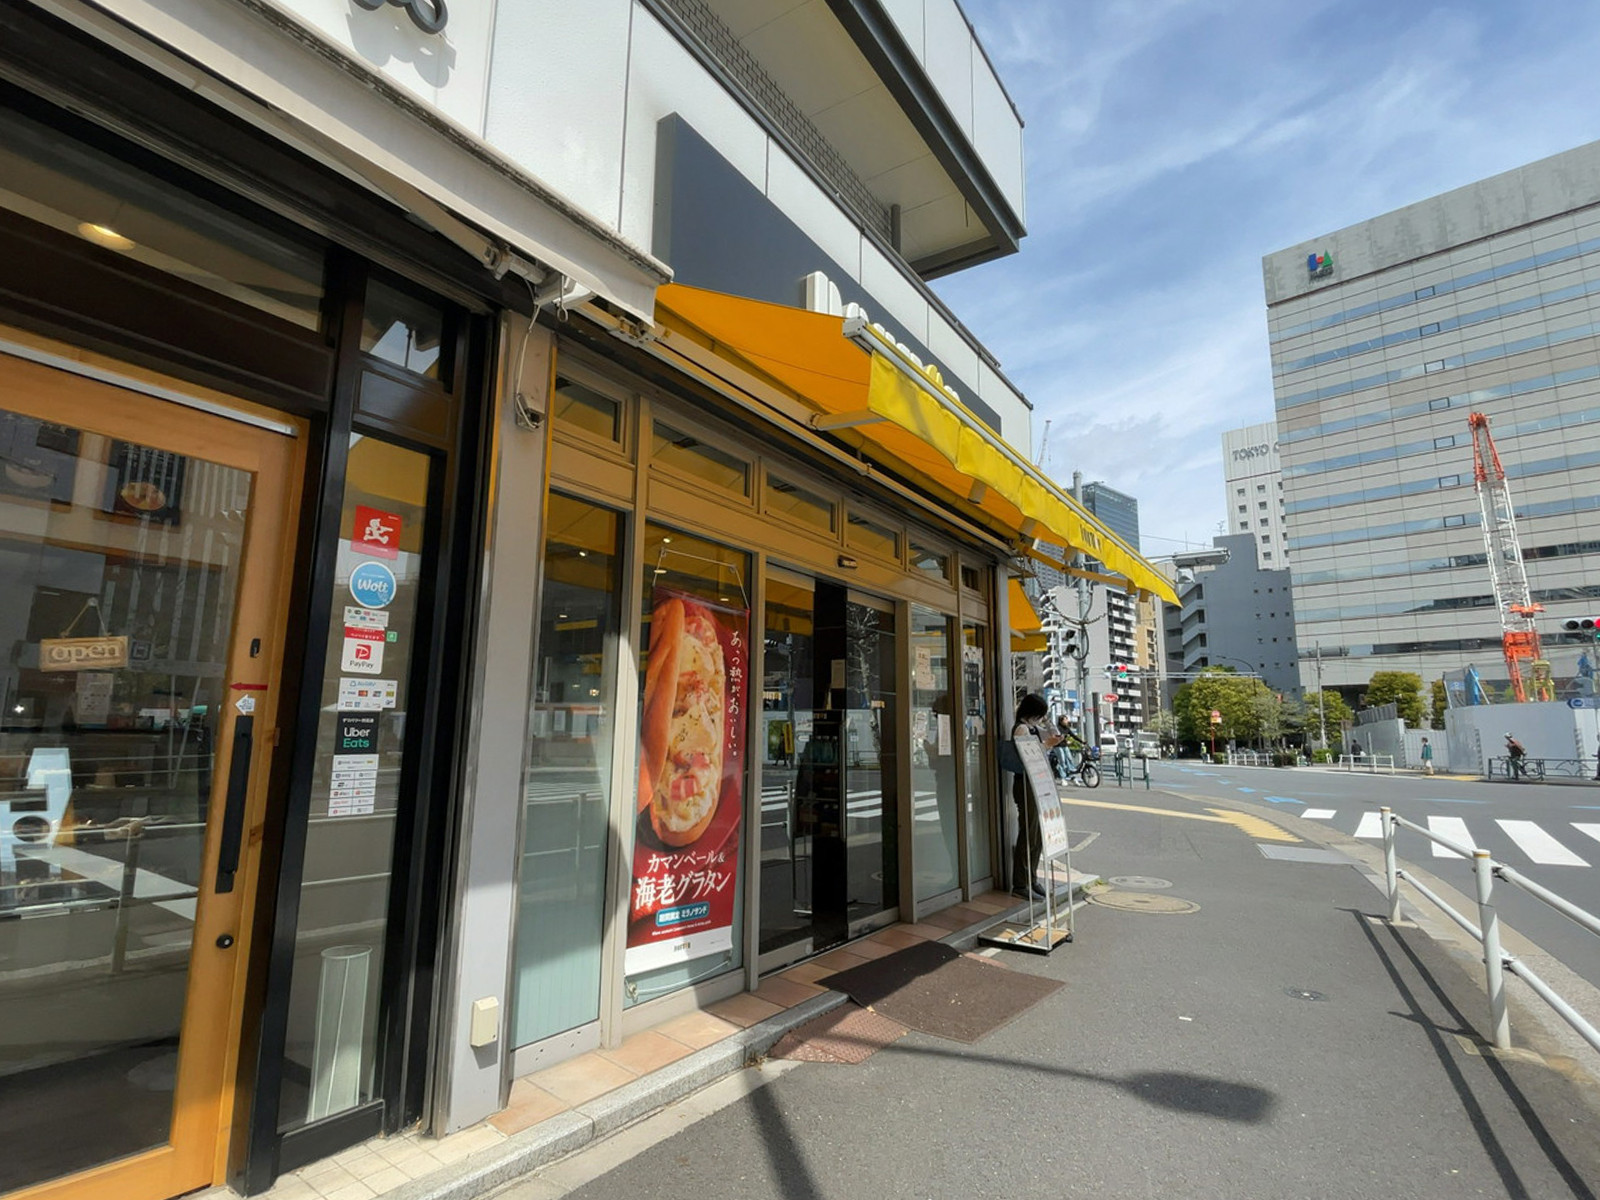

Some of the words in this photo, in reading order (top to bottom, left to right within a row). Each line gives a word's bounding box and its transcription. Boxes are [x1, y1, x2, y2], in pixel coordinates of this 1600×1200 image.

[1232, 443, 1269, 462] TOKYO
[357, 578, 389, 593] Wolt
[51, 643, 120, 664] open
[349, 660, 374, 669] PayPay
[344, 727, 371, 737] Uber
[343, 738, 370, 748] Eats
[647, 850, 726, 874] カマンベール&
[635, 870, 732, 910] 海老グラタン
